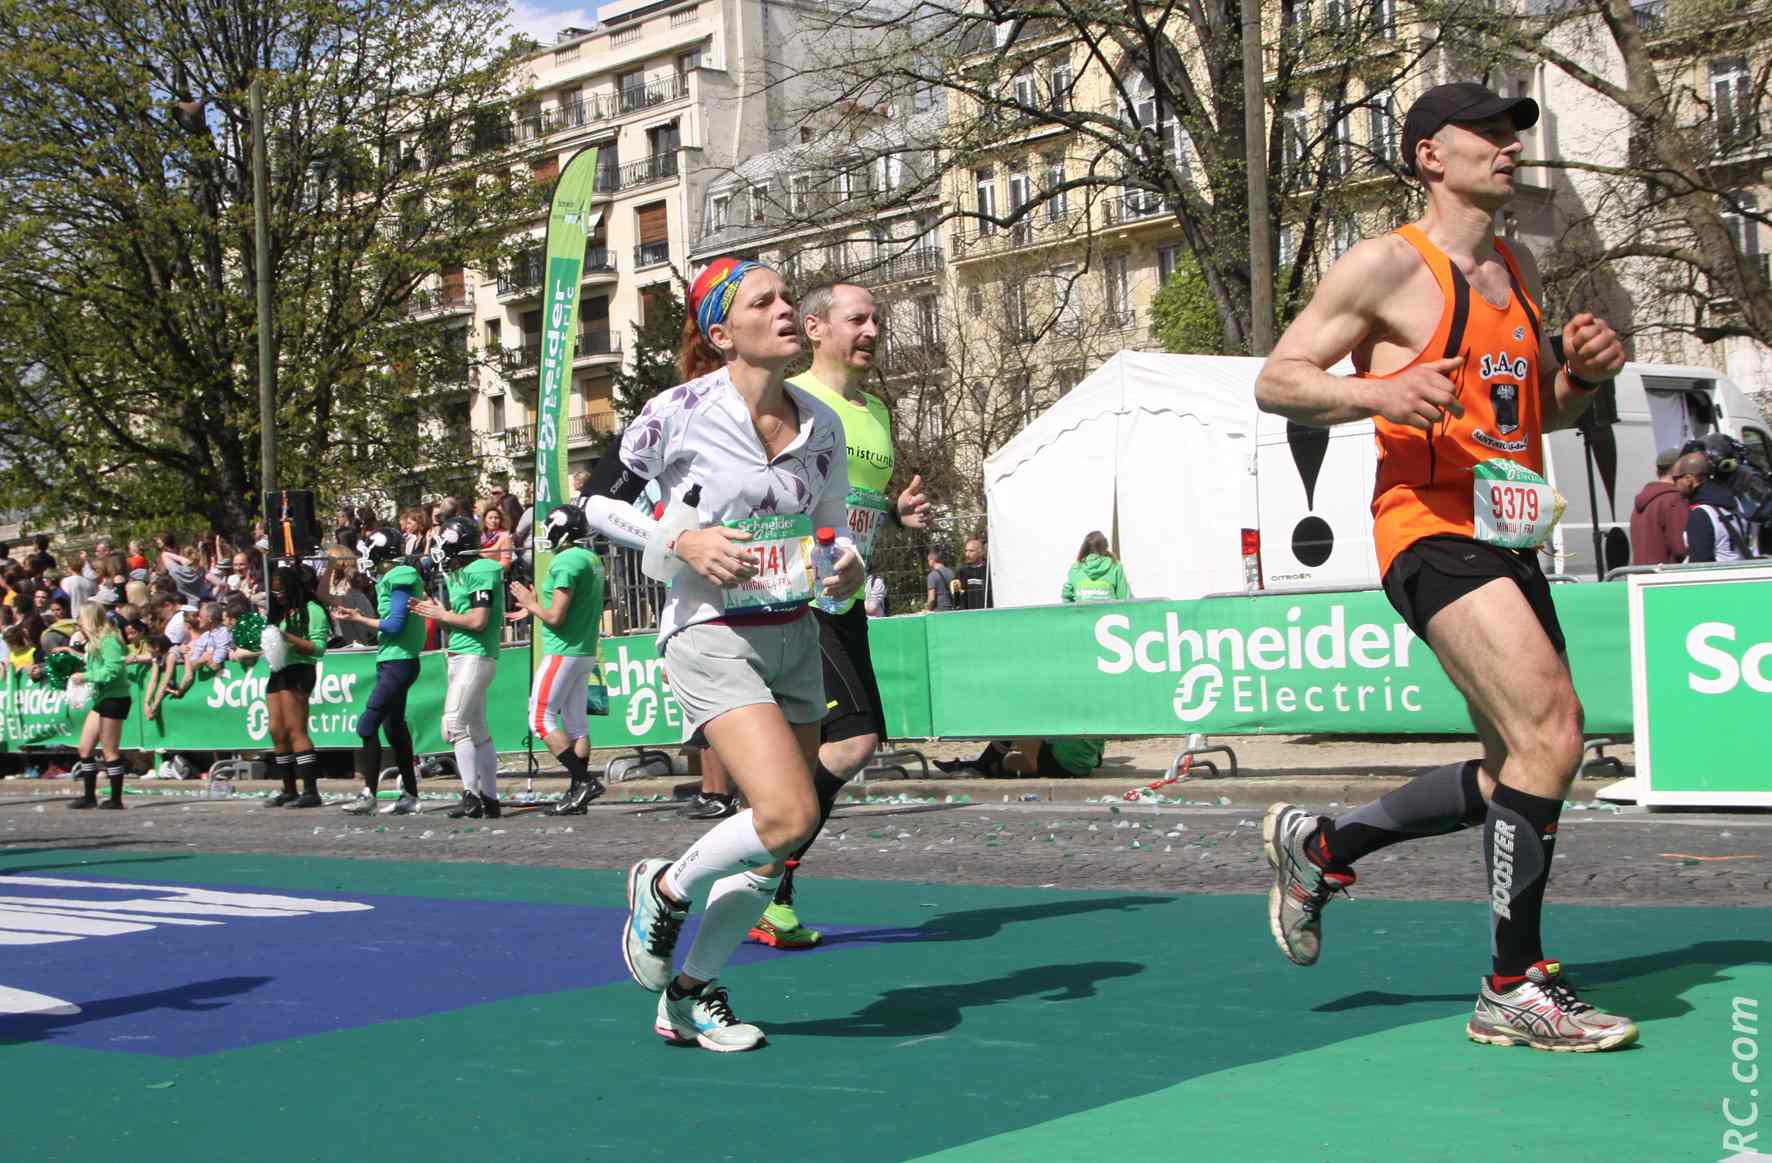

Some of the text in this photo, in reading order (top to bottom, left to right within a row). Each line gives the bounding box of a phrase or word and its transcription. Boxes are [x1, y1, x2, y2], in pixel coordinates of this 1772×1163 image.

[1491, 486, 1539, 521] 9379
[1094, 605, 1416, 674] Schneider
[1232, 675, 1422, 712] Electric
[1493, 820, 1516, 920] BOOSTER
